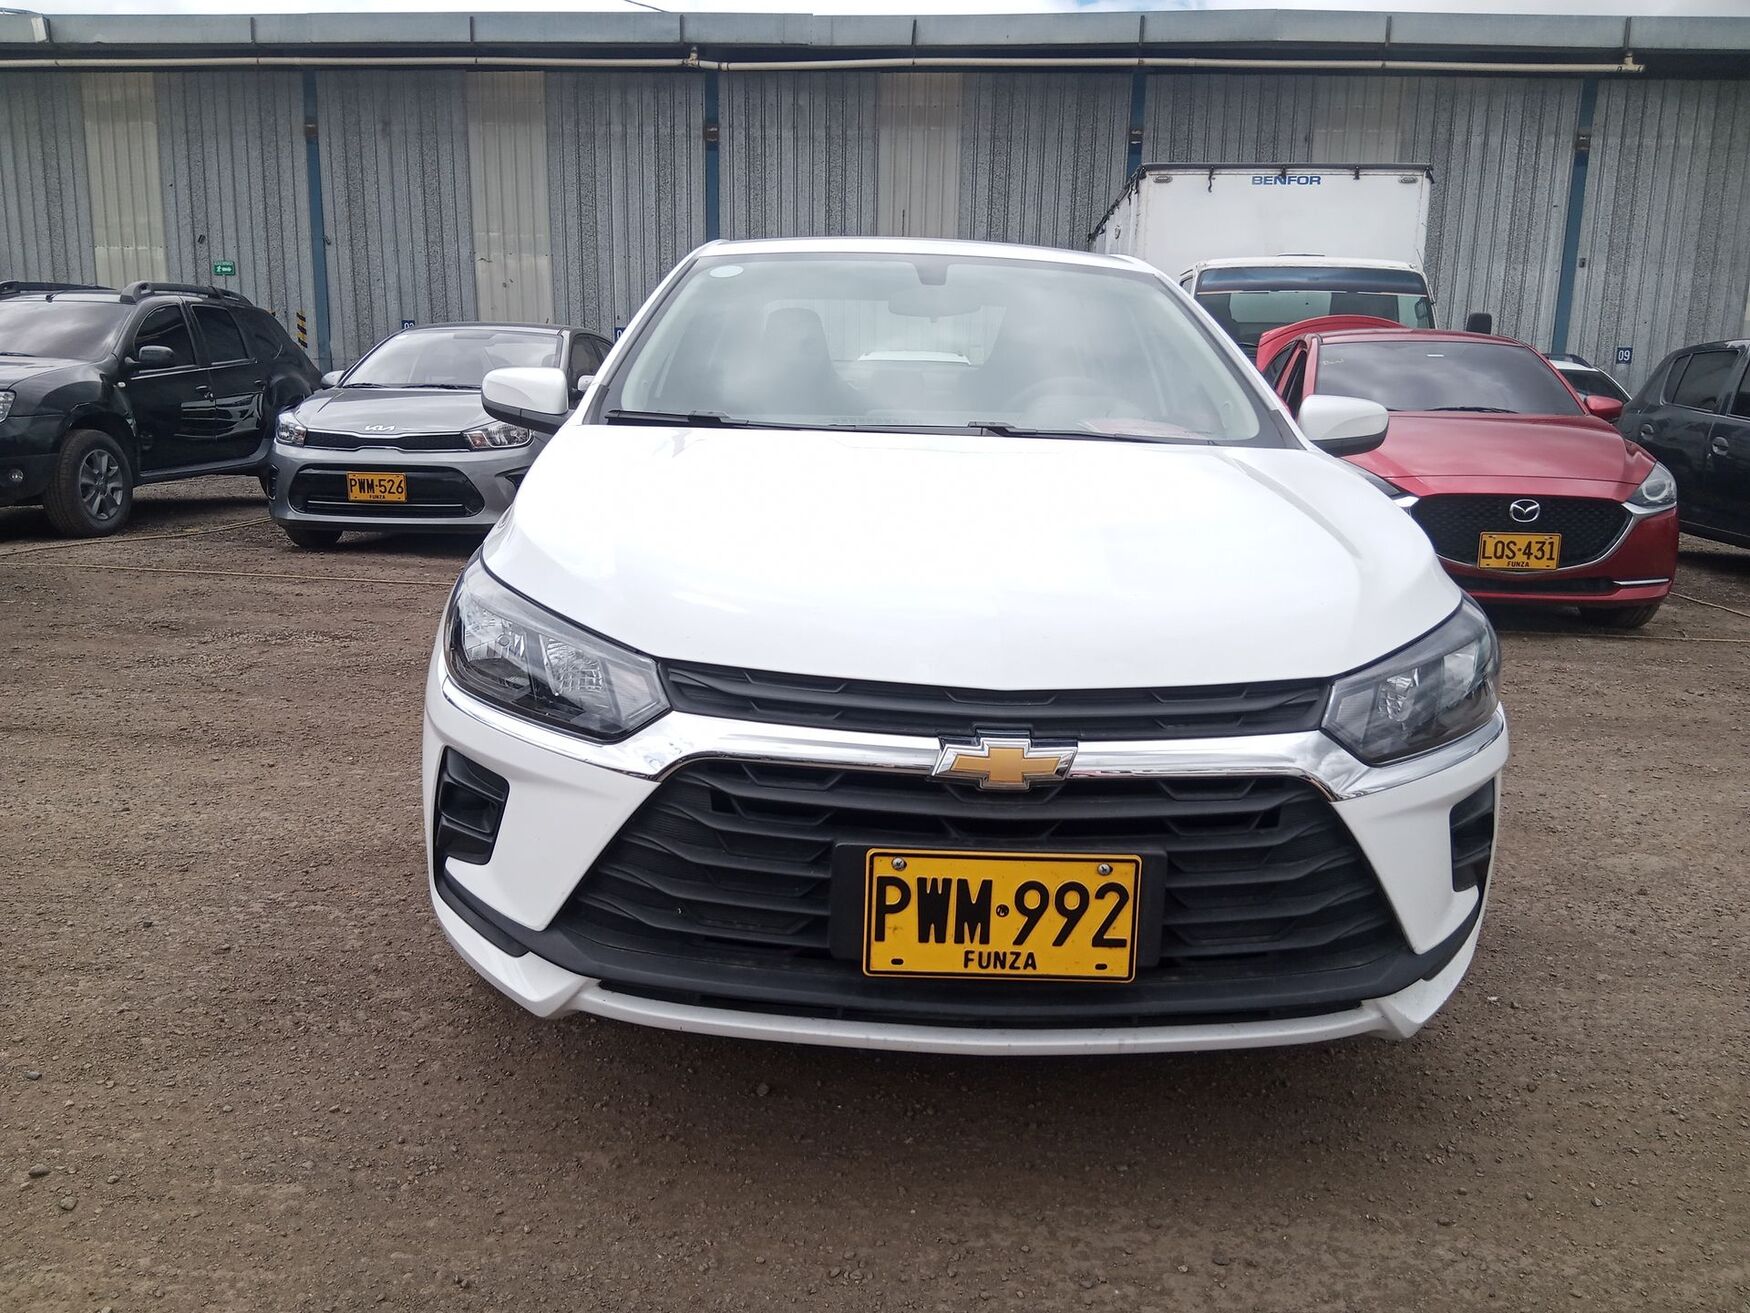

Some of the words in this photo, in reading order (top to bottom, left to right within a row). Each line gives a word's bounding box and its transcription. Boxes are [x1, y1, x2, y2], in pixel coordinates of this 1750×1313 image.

[1251, 176, 1322, 185] BENFOR
[1618, 349, 1631, 361] 09
[963, 950, 1037, 971] FUNZA
